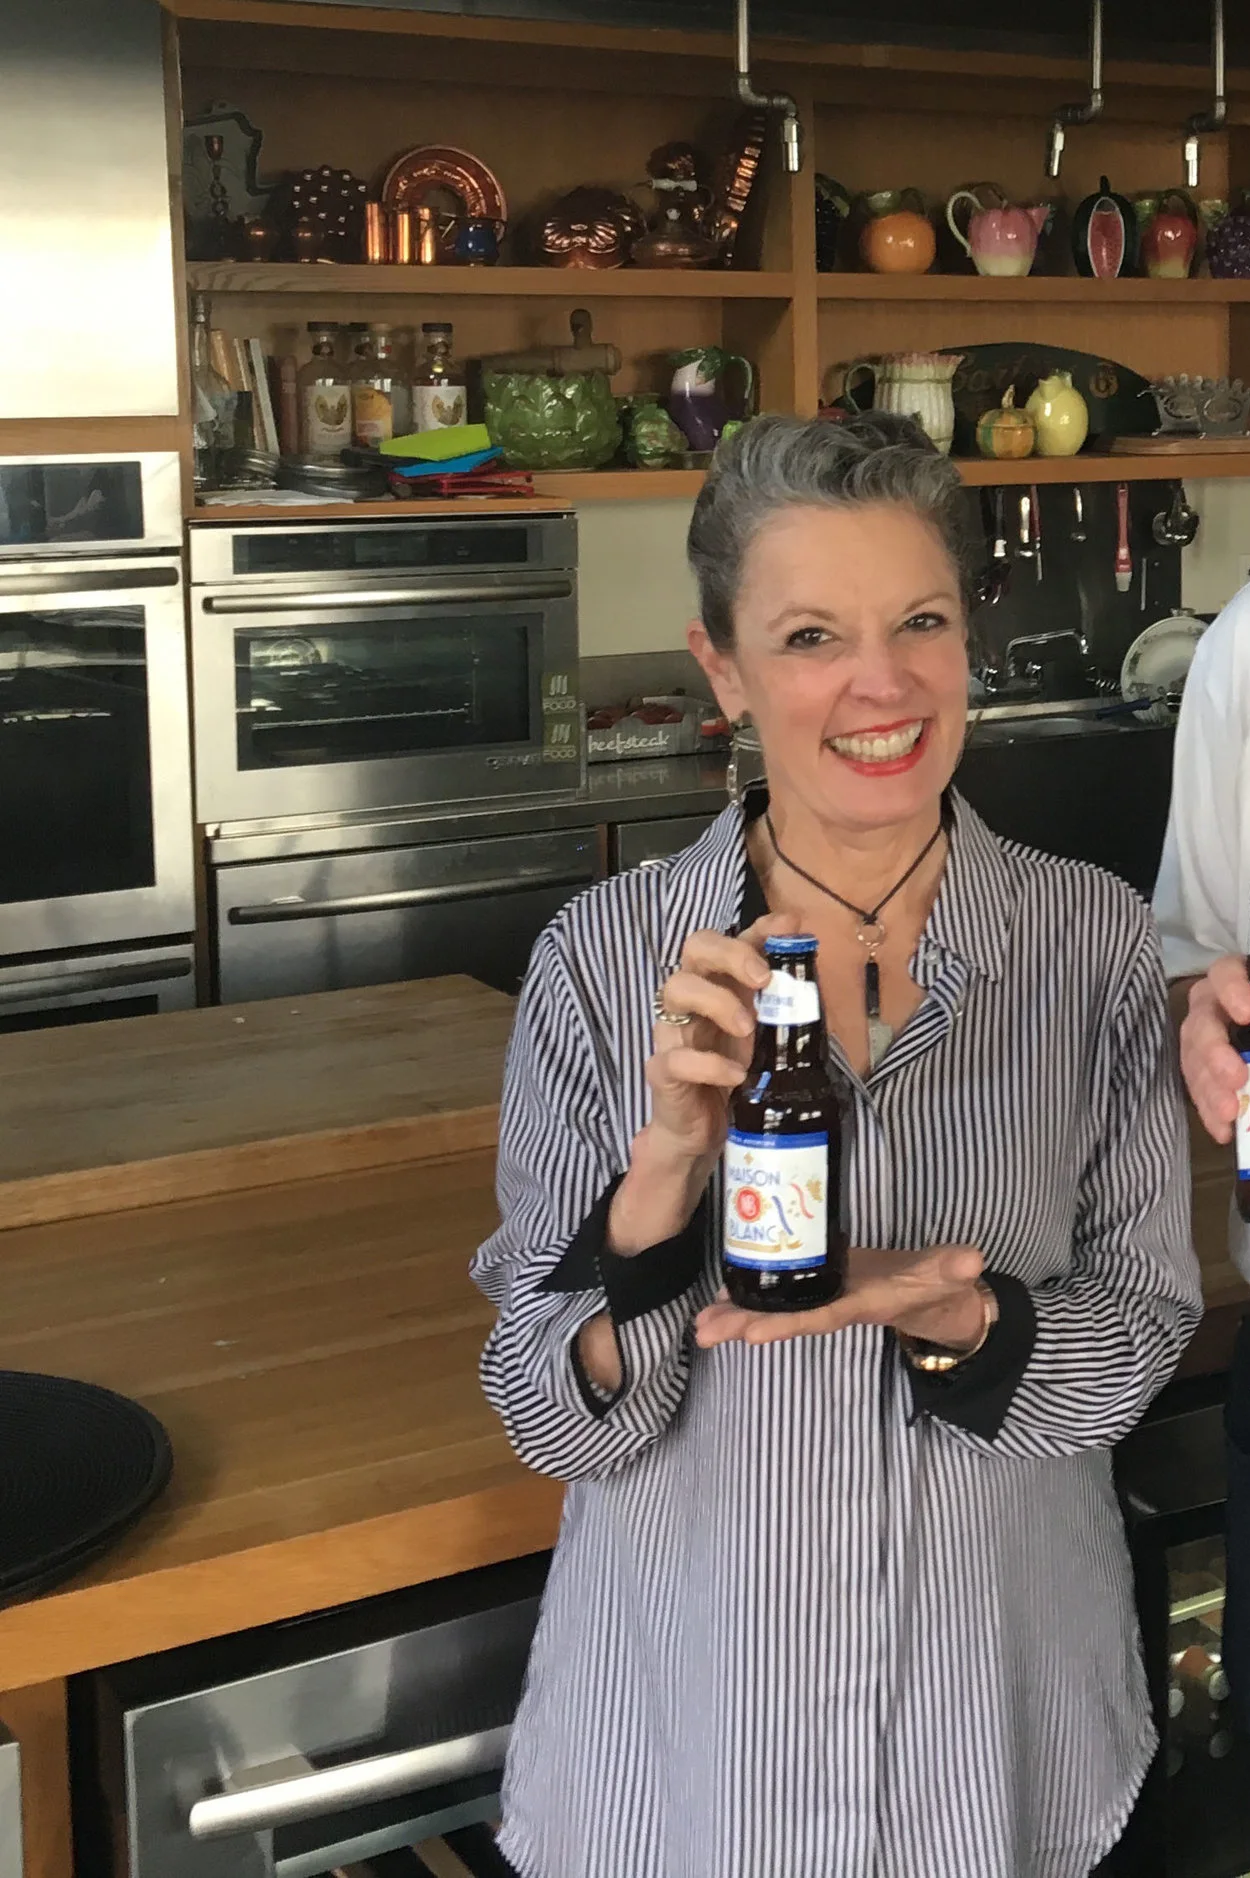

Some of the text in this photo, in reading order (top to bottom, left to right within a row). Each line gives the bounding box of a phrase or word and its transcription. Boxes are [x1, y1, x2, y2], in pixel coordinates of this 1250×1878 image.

[542, 700, 577, 711] FOOD
[543, 749, 577, 759] FOOD
[728, 1166, 781, 1187] MAISON
[729, 1217, 777, 1243] BLANC
